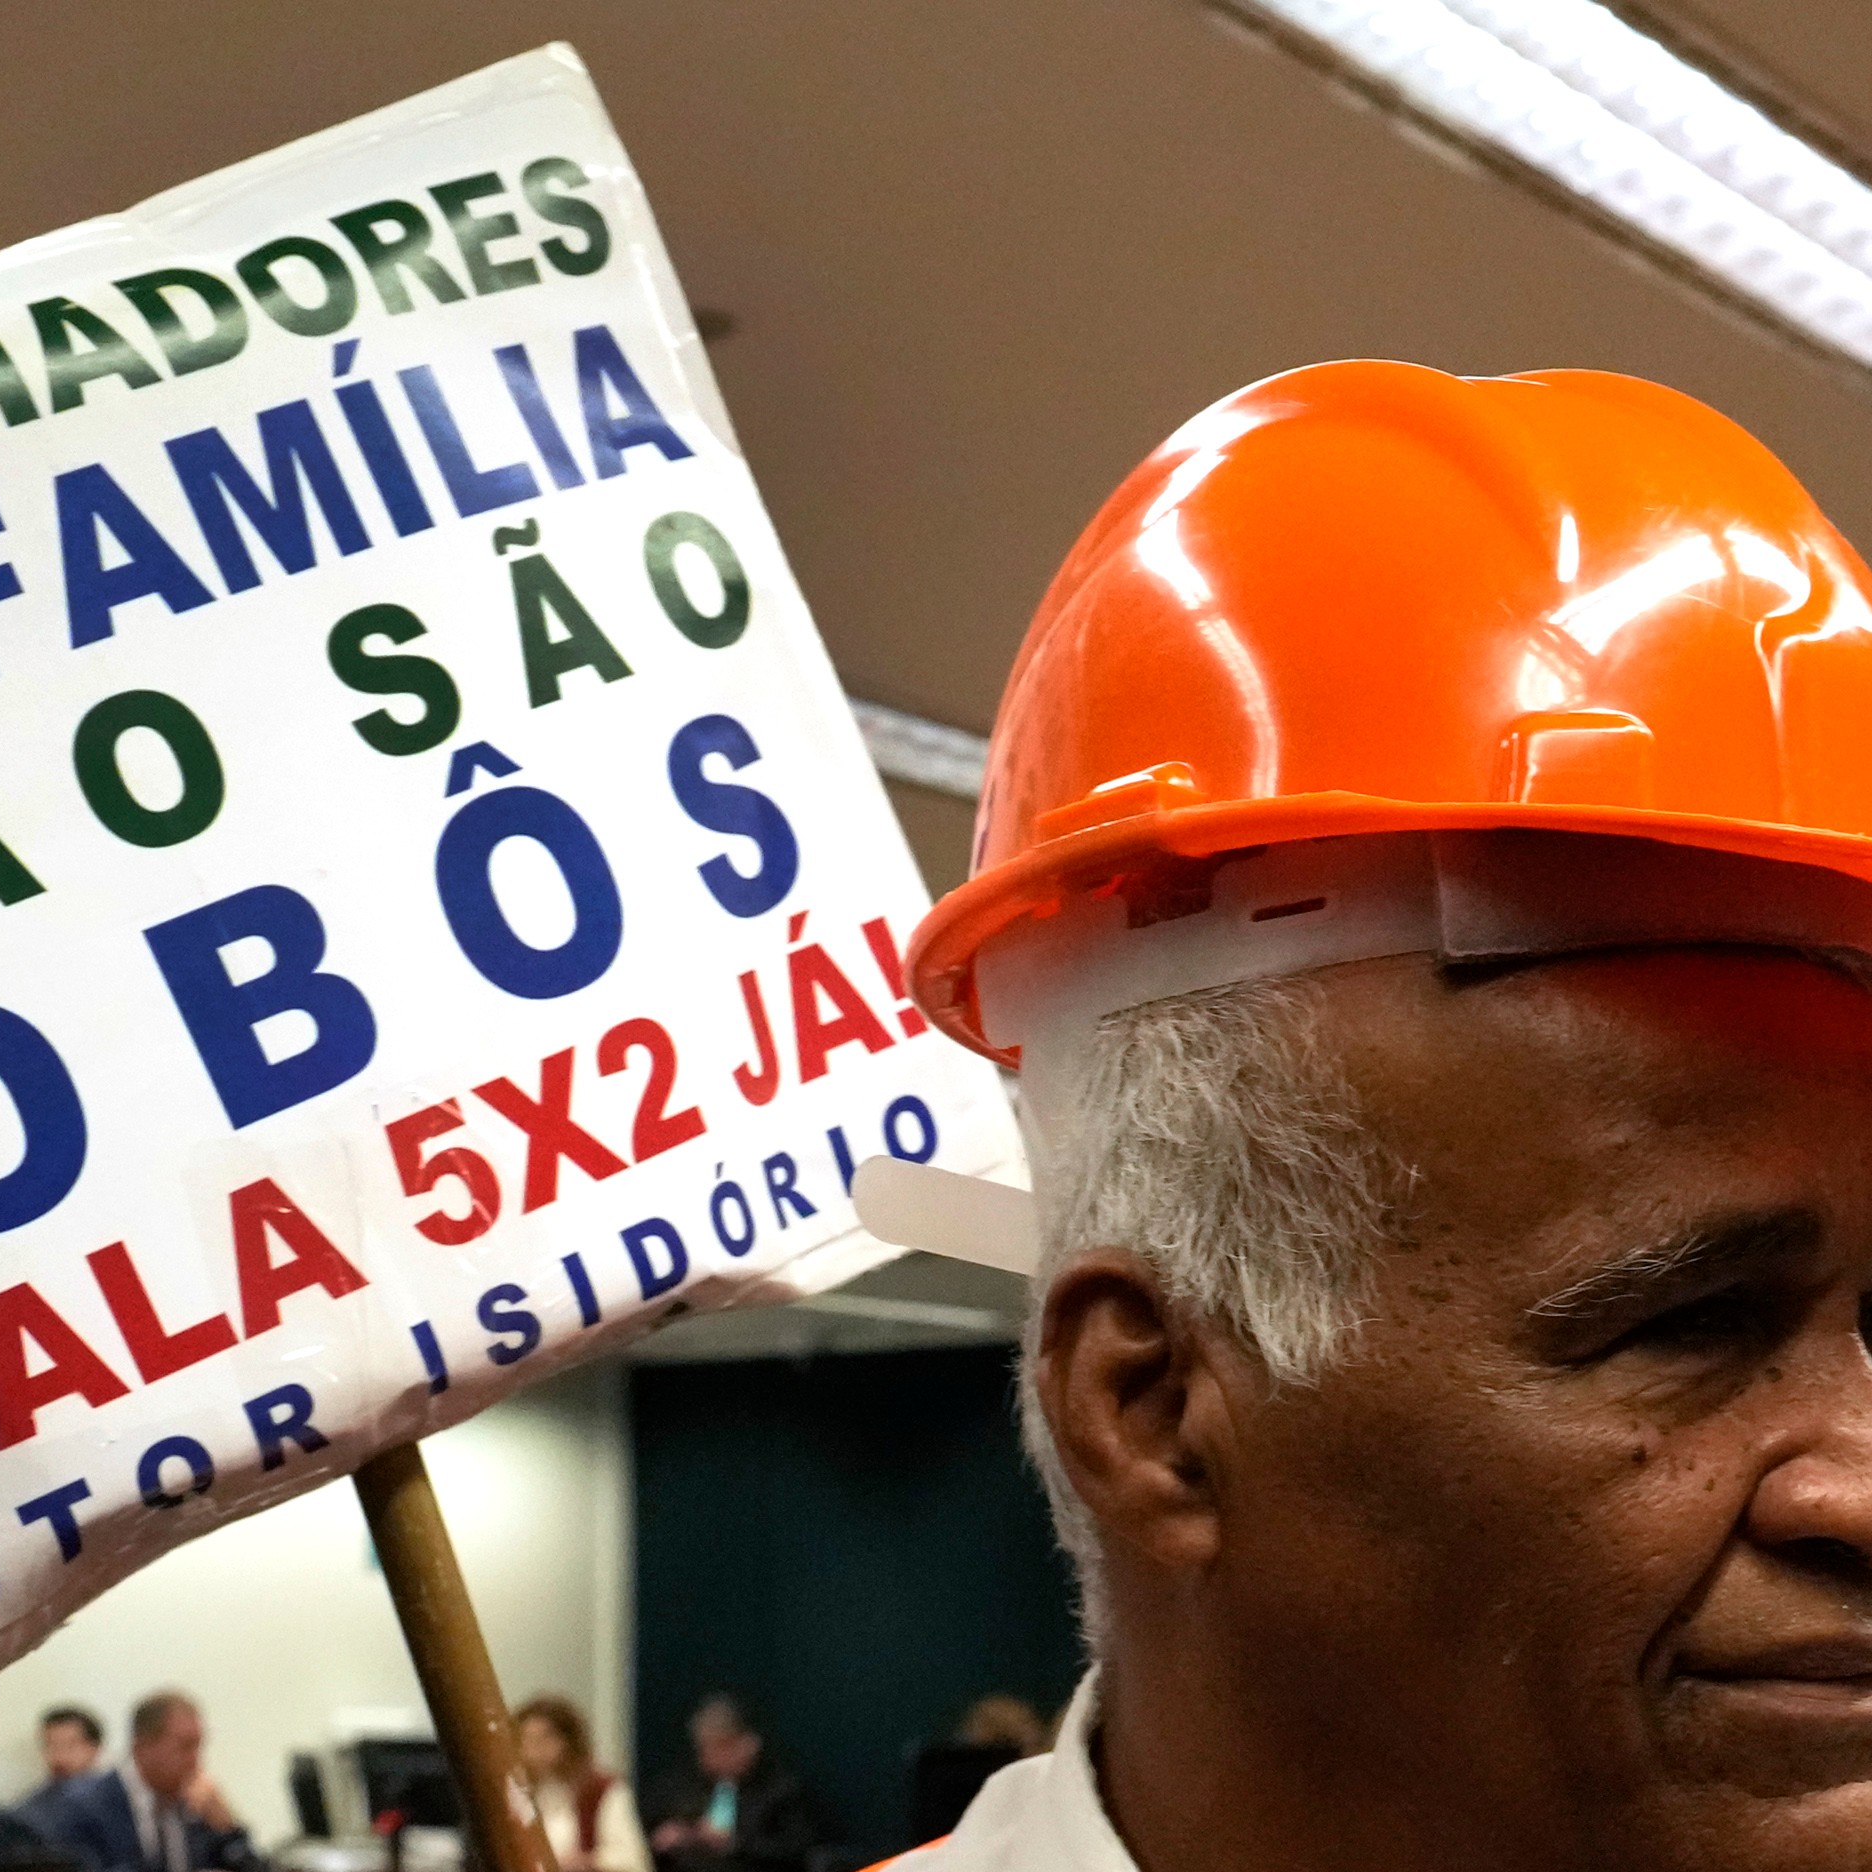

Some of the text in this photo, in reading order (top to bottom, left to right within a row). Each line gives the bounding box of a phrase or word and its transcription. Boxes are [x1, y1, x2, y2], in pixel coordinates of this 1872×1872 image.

[329, 510, 752, 757] SÃO
[386, 1019, 706, 1246] 5X2
[732, 912, 929, 1106] JÁ!
[409, 1095, 938, 1397] ISIDÓRIO
